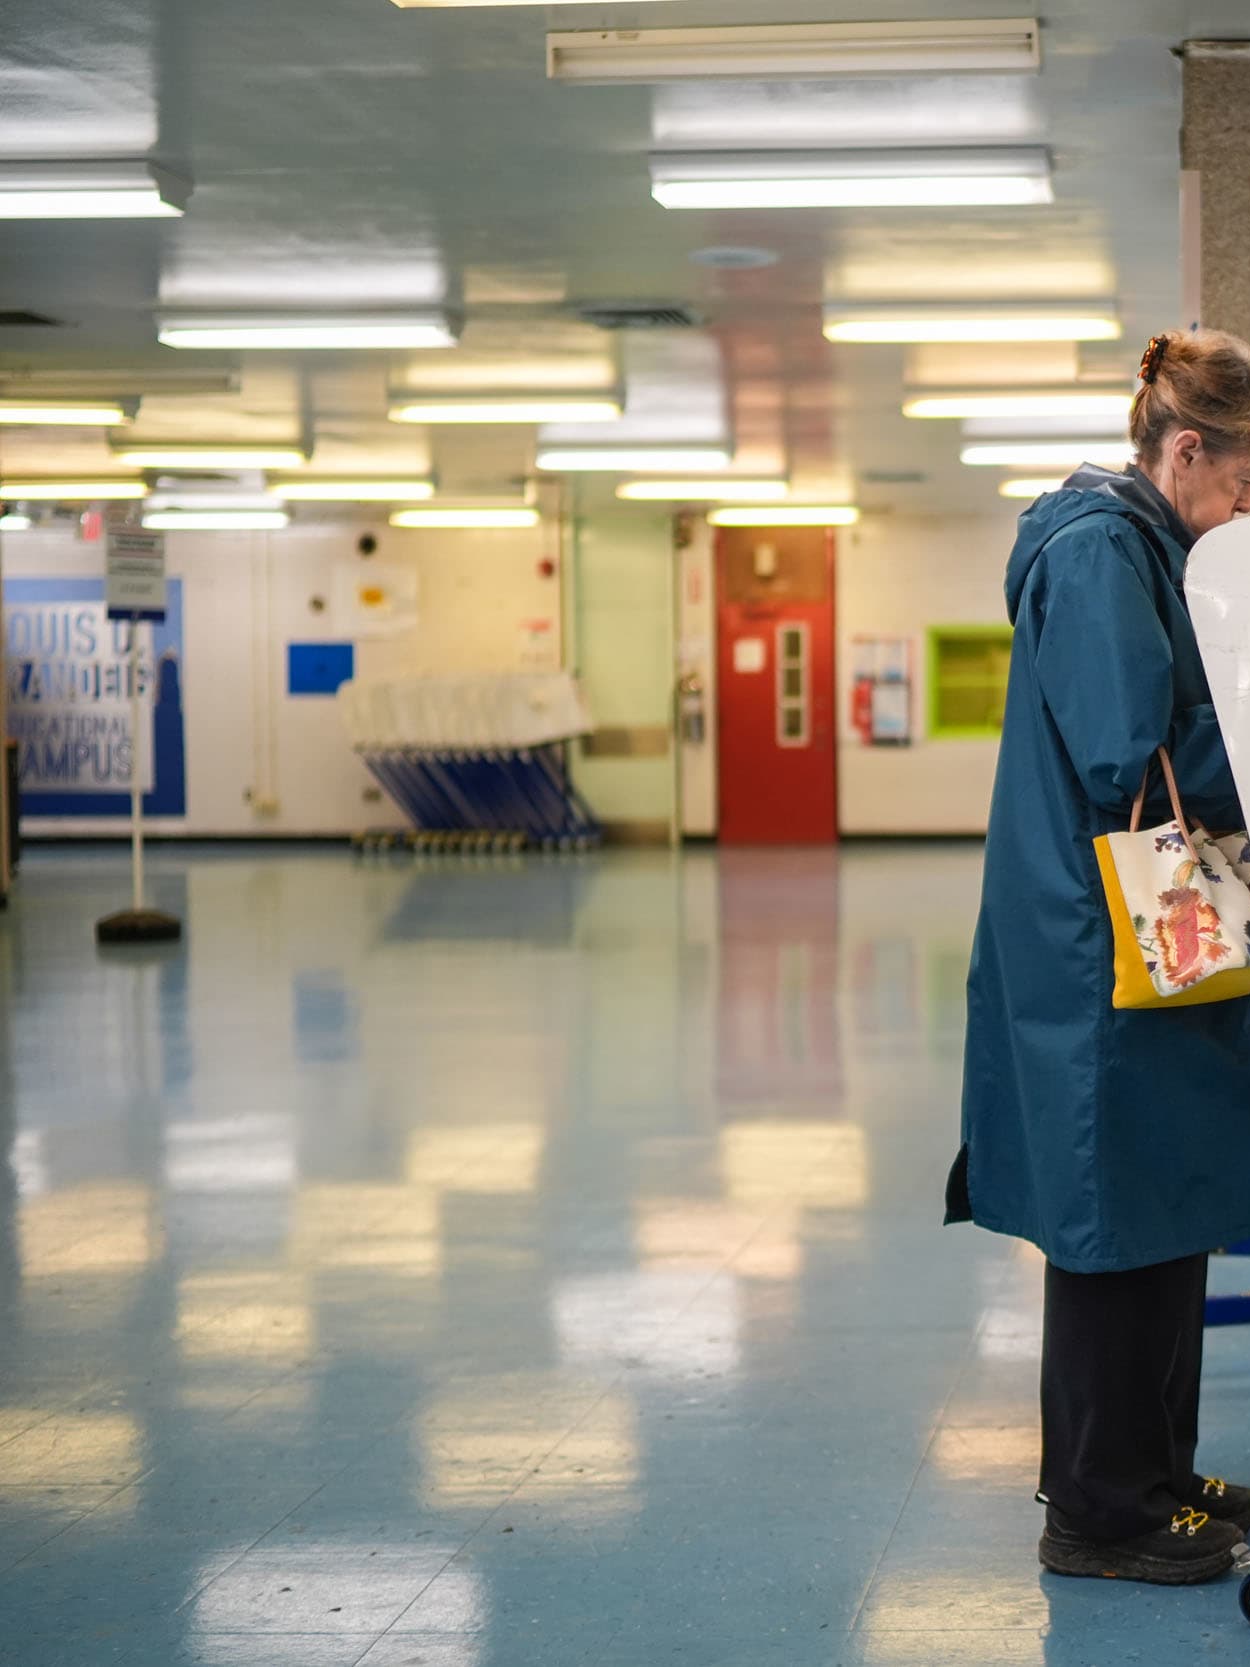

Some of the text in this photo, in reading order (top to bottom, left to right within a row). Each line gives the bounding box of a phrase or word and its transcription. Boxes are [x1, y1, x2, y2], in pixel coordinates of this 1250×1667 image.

[8, 611, 98, 656] OUIS
[8, 713, 128, 737] DUCATIONAL
[20, 740, 133, 782] AMPUS
